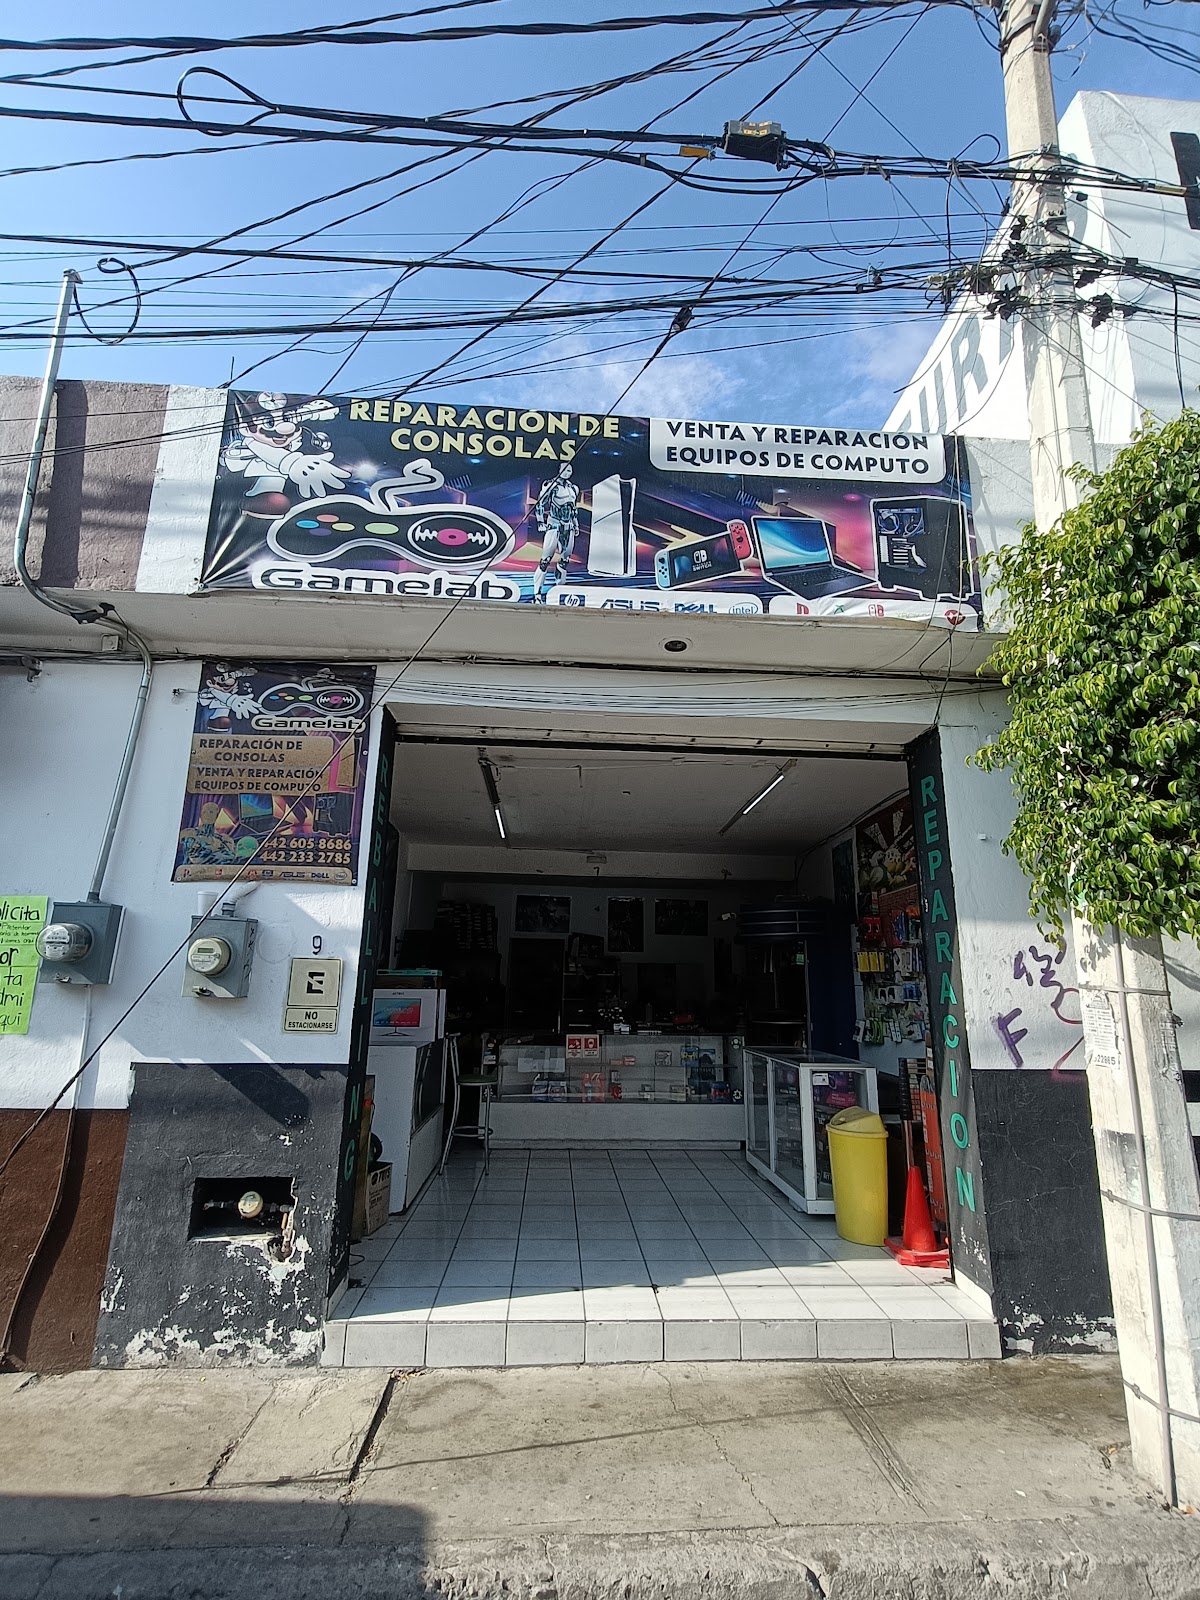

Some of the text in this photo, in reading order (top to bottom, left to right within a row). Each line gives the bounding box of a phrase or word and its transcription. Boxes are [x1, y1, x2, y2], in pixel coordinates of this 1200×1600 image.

[350, 398, 619, 439] REPARACIÓN DE
[666, 421, 929, 451] VENTA Y REPARACIÓN
[391, 428, 576, 461] CONSOLAS
[666, 446, 930, 475] EQUIPOS DE COMPUTO
[260, 569, 513, 600] Gamelab
[600, 598, 661, 612] ASUS
[674, 602, 718, 614] DELL
[731, 603, 757, 615] intel
[254, 717, 363, 730] Gamelab
[200, 738, 303, 751] REPARACIÓN DE
[214, 751, 286, 763] CONSOLAS
[196, 766, 323, 779] VENTA Y REPARACIÓN
[194, 780, 321, 793] EQUIPOS DE COMPUTO
[289, 837, 315, 849] 605
[318, 838, 352, 851] 8686
[260, 851, 351, 864] 442 233 2785
[0, 901, 40, 921] licita
[344, 754, 388, 1181] REBALLING
[920, 775, 976, 1213] REPARACION
[304, 1011, 318, 1021] NO
[288, 1021, 334, 1030] ESTACIONARSE
